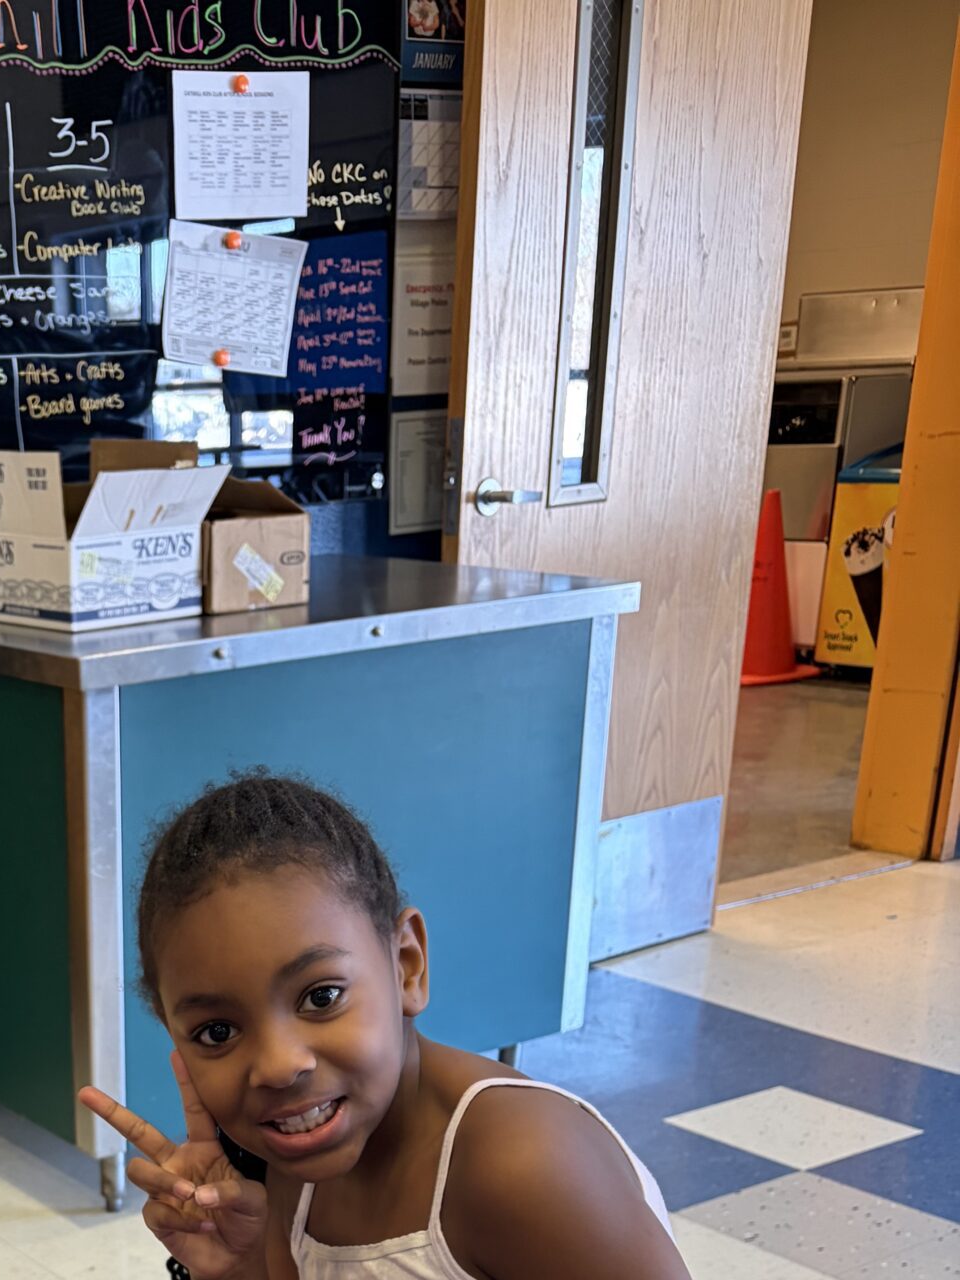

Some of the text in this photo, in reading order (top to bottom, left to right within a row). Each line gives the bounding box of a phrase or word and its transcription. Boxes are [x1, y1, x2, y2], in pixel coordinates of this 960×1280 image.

[412, 52, 456, 69] JANUARY
[49, 117, 113, 163] 3-5
[331, 163, 367, 184] CKC
[95, 179, 145, 205] Writing
